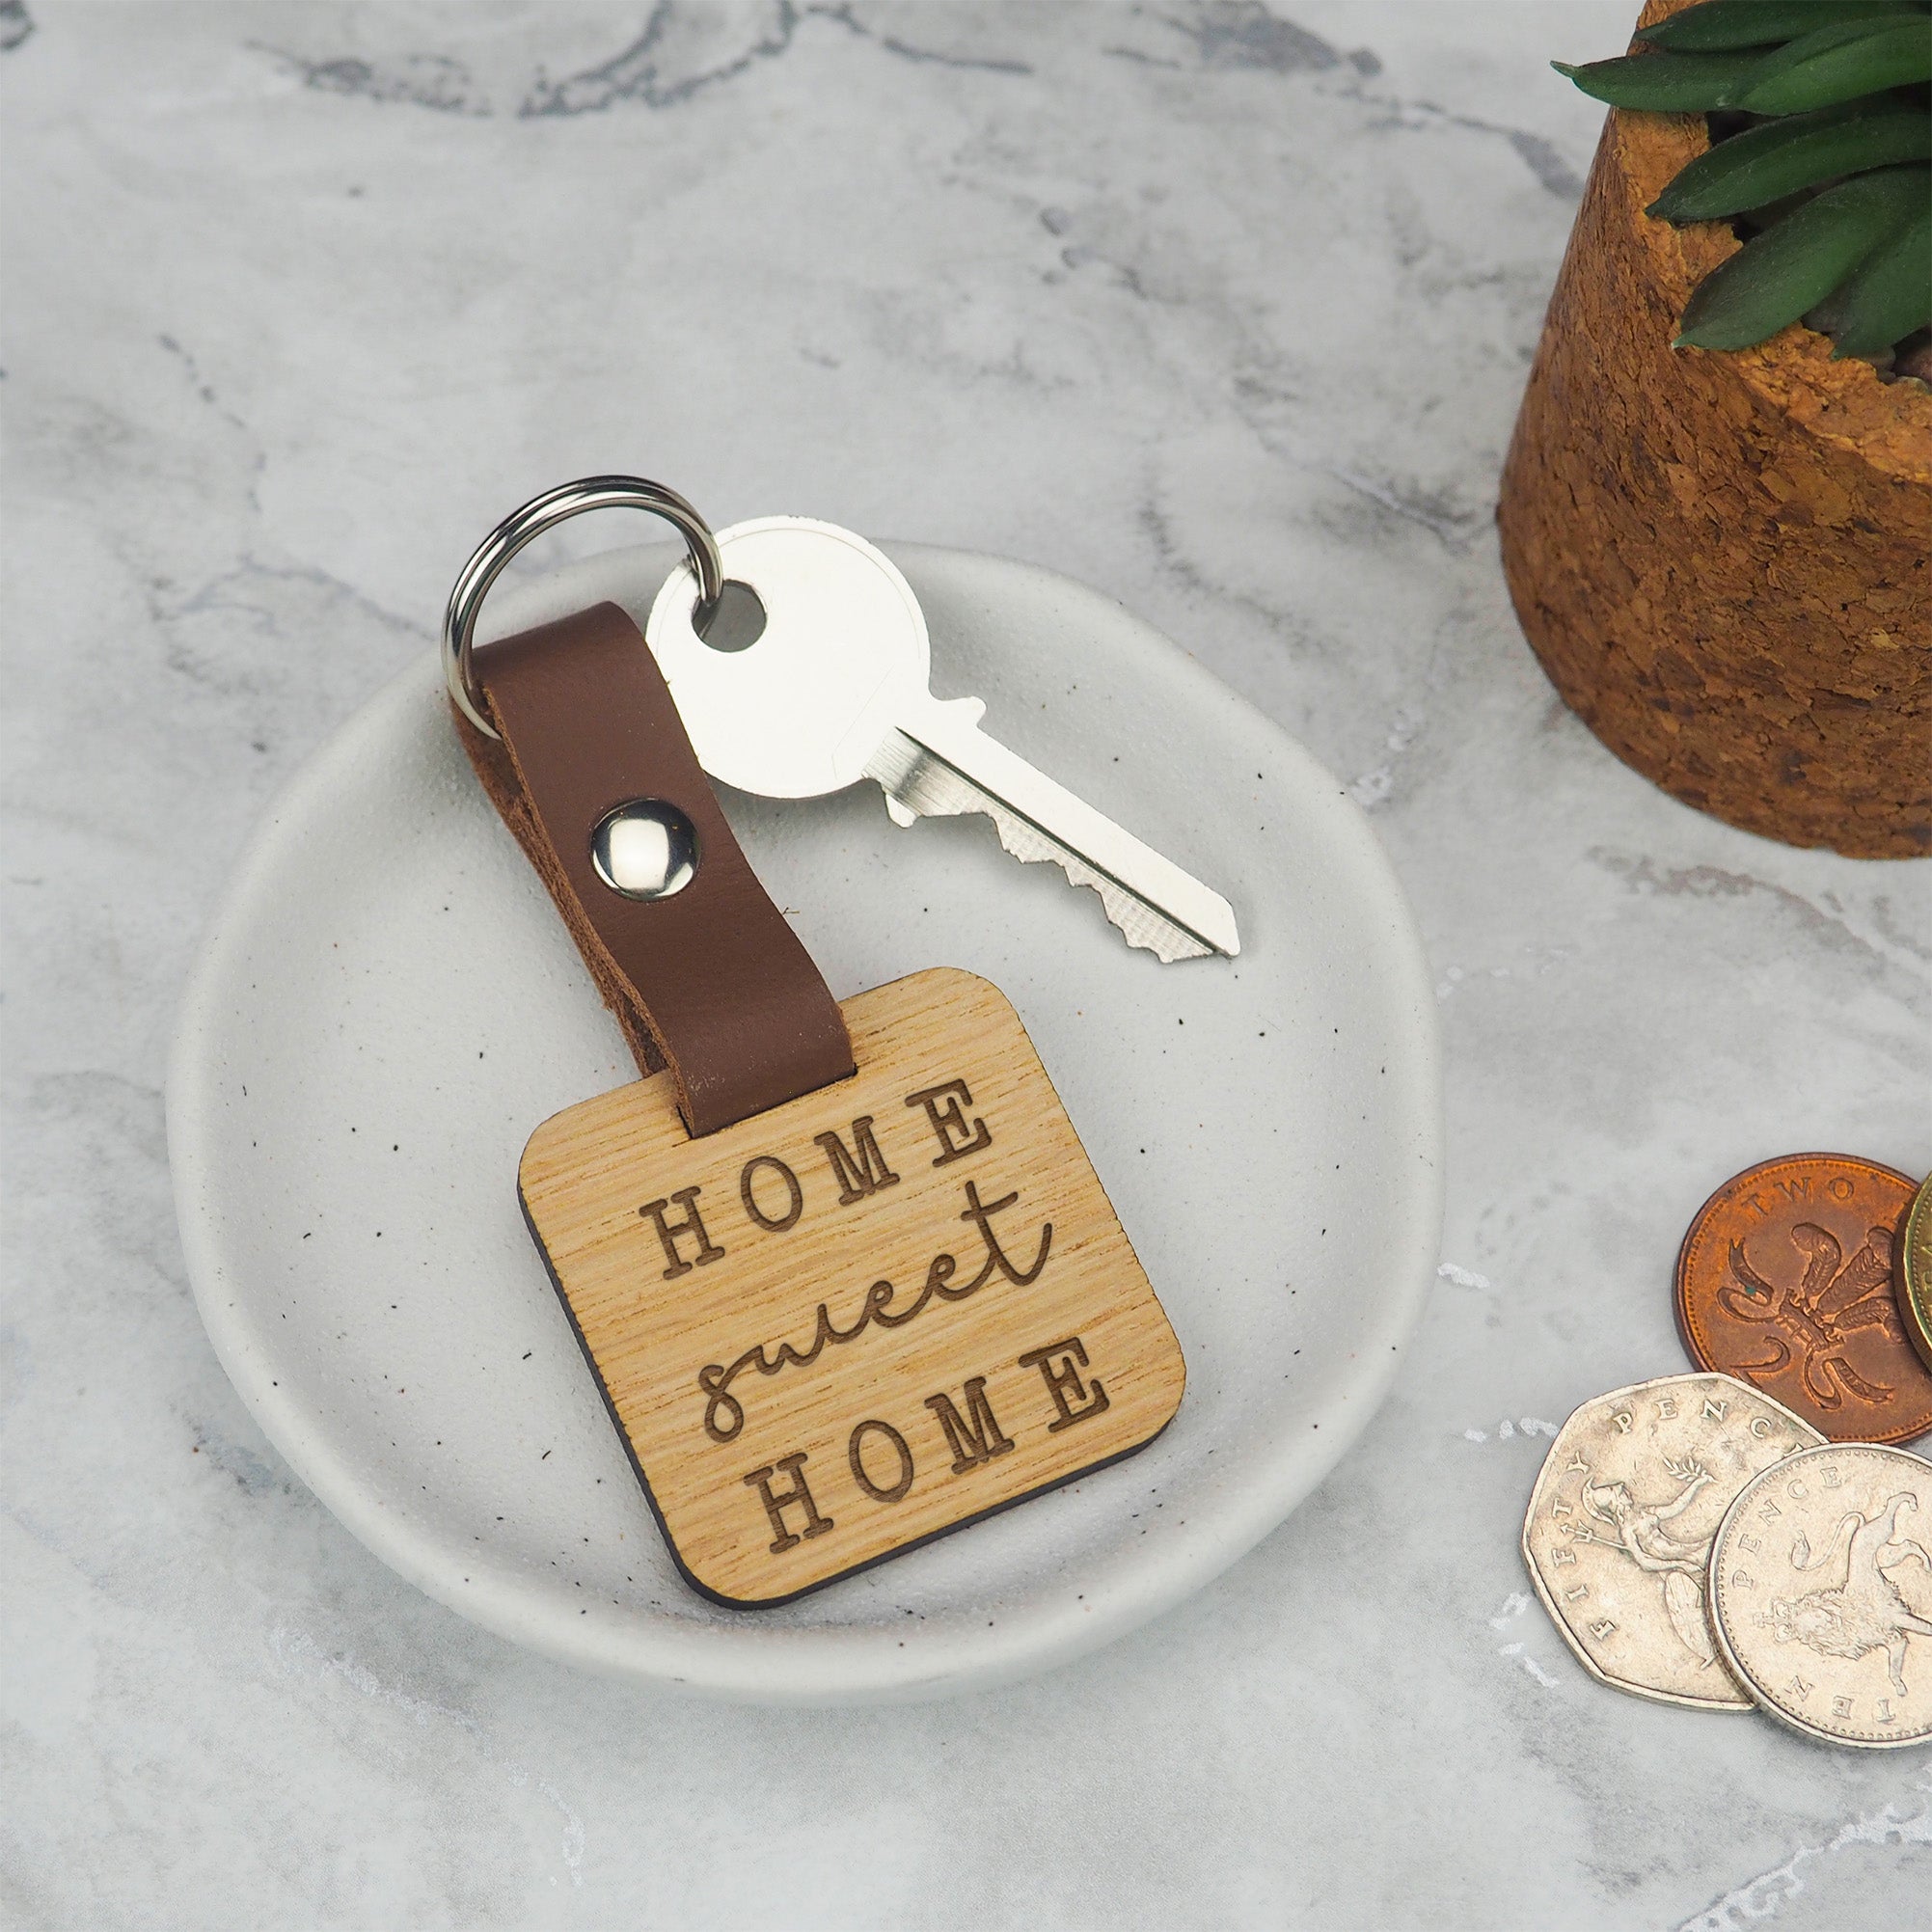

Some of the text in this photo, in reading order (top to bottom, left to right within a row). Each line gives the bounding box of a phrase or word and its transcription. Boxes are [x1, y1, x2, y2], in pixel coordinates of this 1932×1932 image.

[639, 1077, 993, 1281] HOME
[1741, 1176, 1855, 1217] TWO
[697, 1179, 1053, 1444] sweet
[743, 1335, 1111, 1555] HOME
[1552, 1451, 1617, 1641] FIFTY
[1731, 1465, 1896, 1725] TEN PENCE
